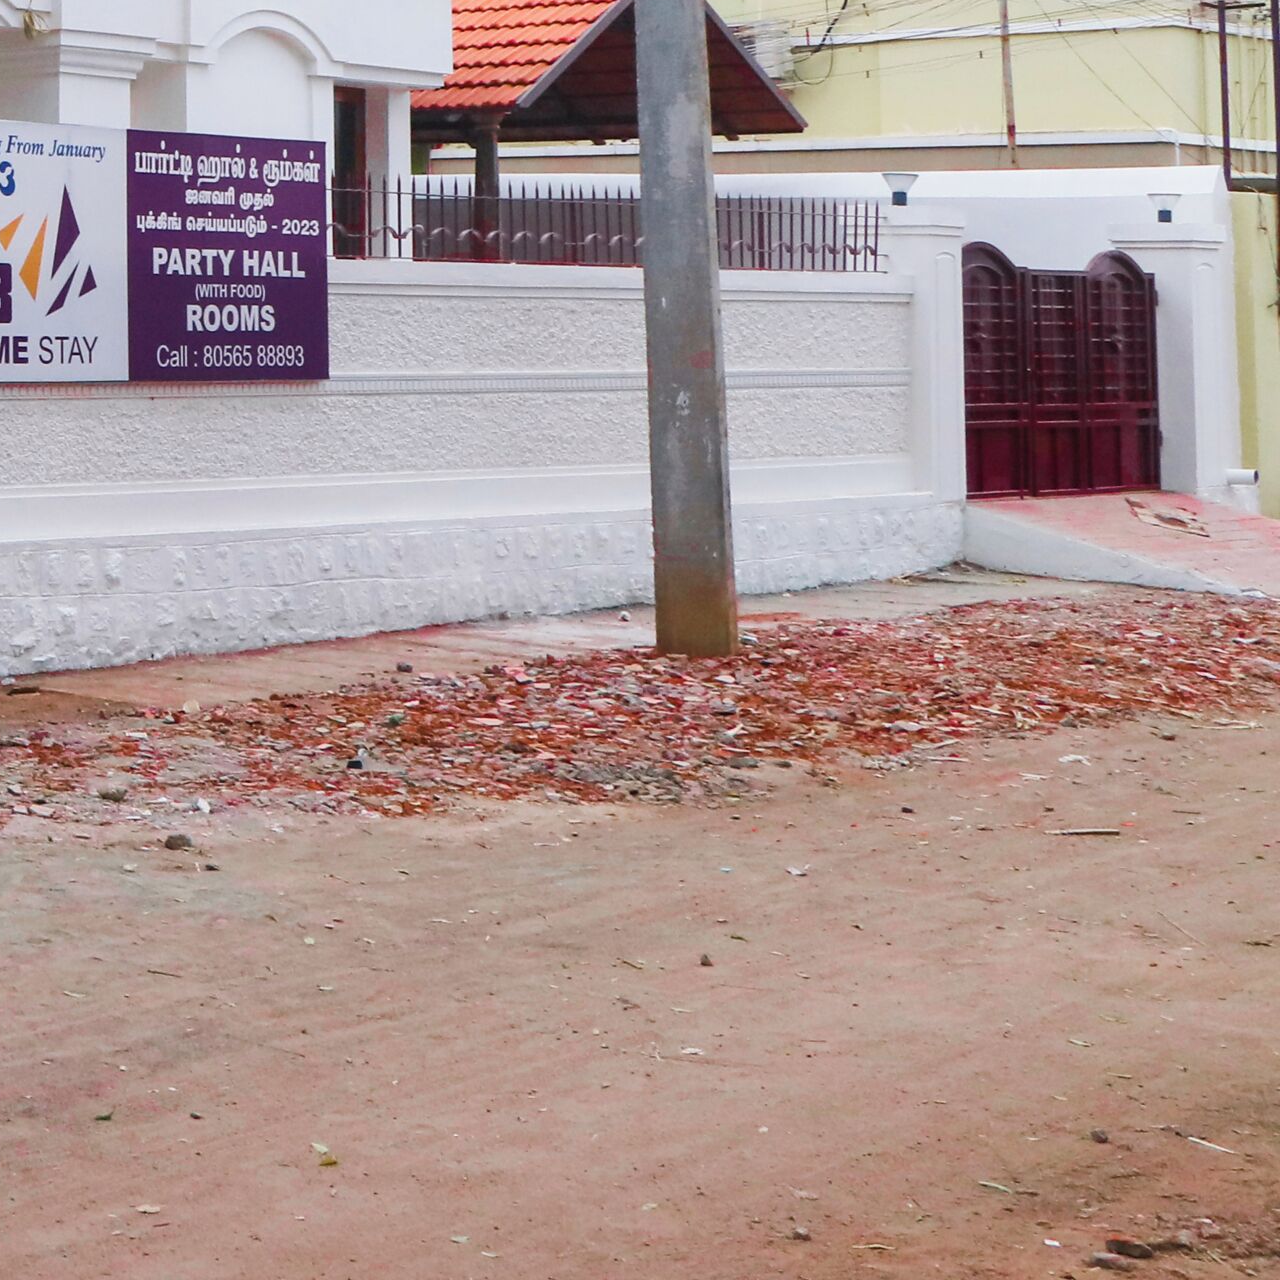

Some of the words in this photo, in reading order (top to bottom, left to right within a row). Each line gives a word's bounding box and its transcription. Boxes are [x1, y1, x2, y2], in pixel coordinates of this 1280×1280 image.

[5, 135, 44, 156] From
[48, 140, 105, 162] January
[135, 140, 193, 183] பார்ட்டி
[197, 144, 246, 186] ஹால்
[249, 156, 259, 178] &
[263, 149, 320, 187] ரூம்கள்
[239, 189, 274, 210] முதல்
[136, 210, 182, 232] புக்கிங்
[186, 212, 267, 237] செய்யப்படும்
[282, 219, 319, 236] 2023
[152, 247, 235, 276] PARTY
[243, 250, 306, 278] HALL
[195, 284, 228, 301] (WITH
[230, 285, 266, 301] FOOD)
[186, 305, 276, 331] ROOMS
[38, 336, 98, 364] STAY
[156, 344, 188, 367] Call
[203, 345, 252, 366] 80565
[257, 345, 305, 366] 88893
